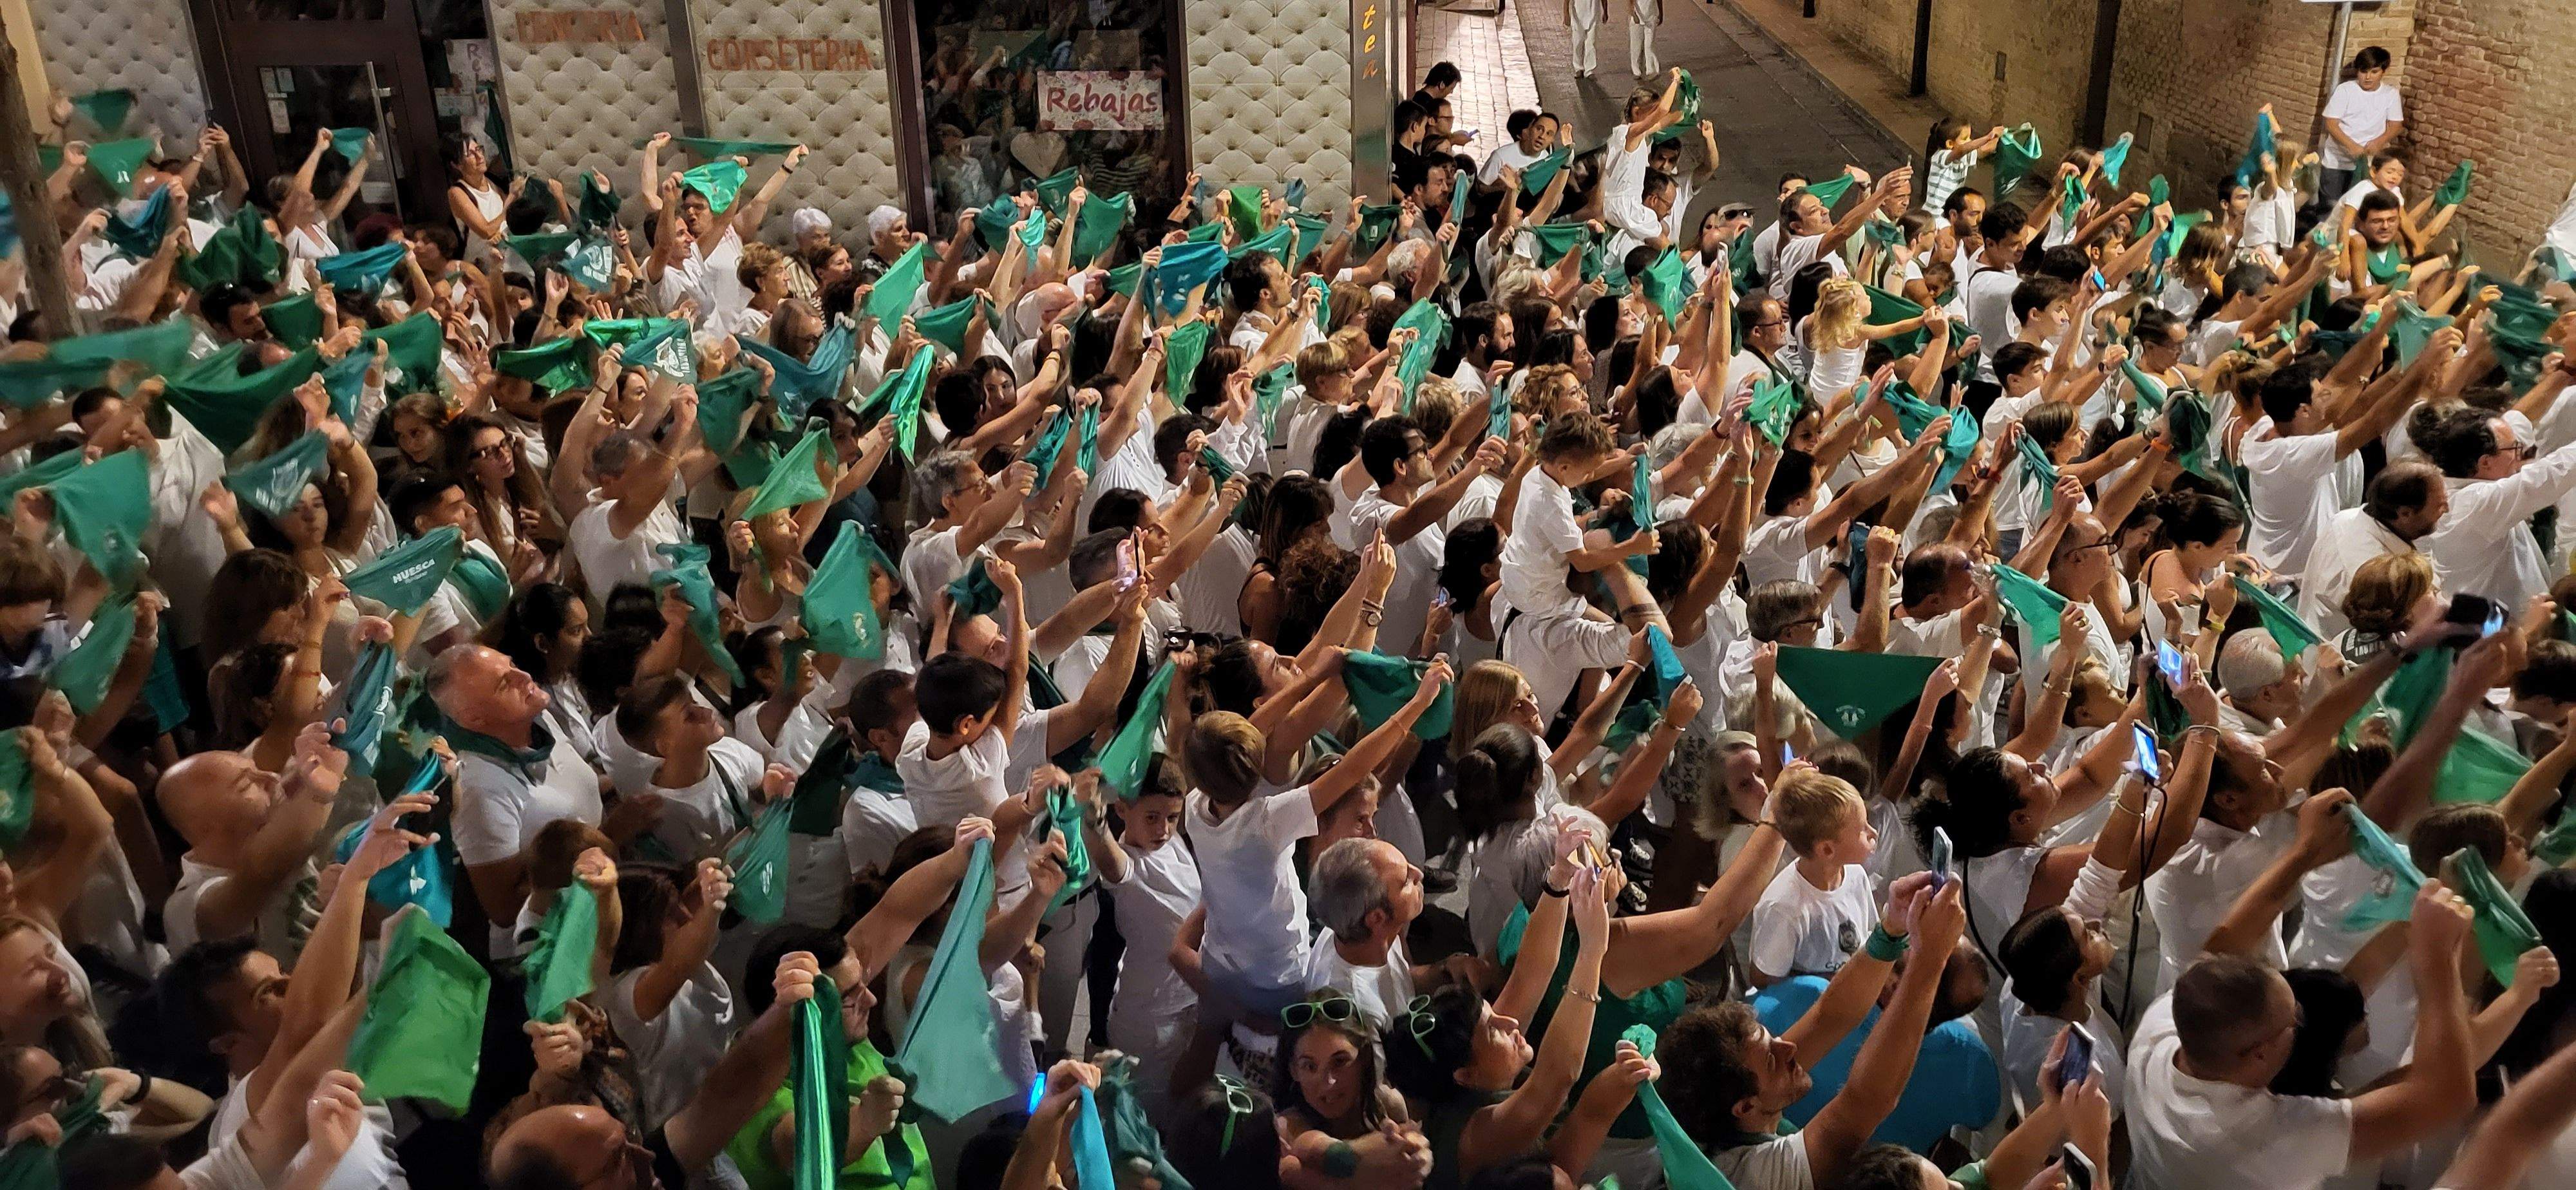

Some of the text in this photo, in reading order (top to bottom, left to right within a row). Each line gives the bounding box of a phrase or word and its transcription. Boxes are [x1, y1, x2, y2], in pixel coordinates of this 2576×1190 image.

[706, 37, 873, 71] CORSETERIA
[1046, 82, 1158, 122] Rebajas
[392, 558, 436, 585] HUESCA
